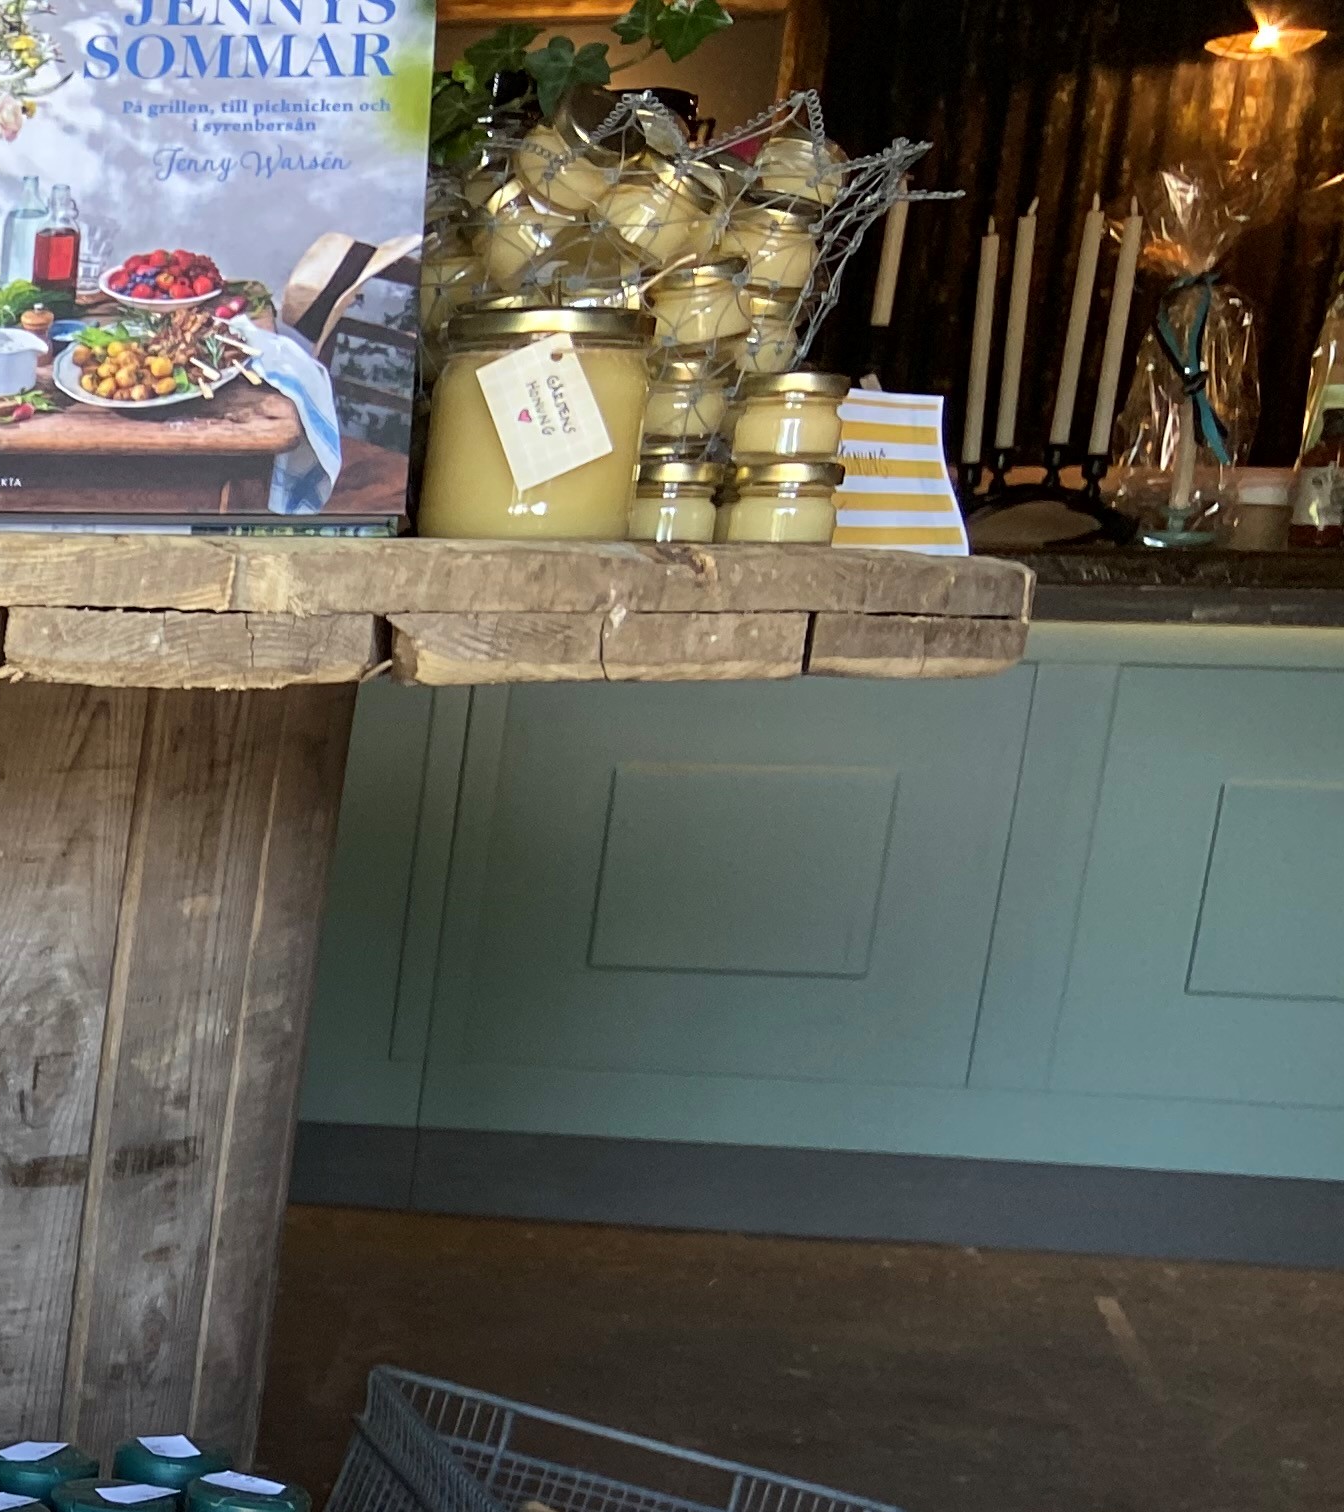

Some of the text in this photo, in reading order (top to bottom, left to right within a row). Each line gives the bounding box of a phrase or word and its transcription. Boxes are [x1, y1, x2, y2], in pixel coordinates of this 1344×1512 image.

[124, 0, 396, 26] JENNYS
[83, 32, 395, 79] SOMMAR
[121, 98, 392, 118] På grillen, till picknicken och
[203, 117, 316, 134] syrenbersån
[153, 144, 351, 182] Jenny Warsén
